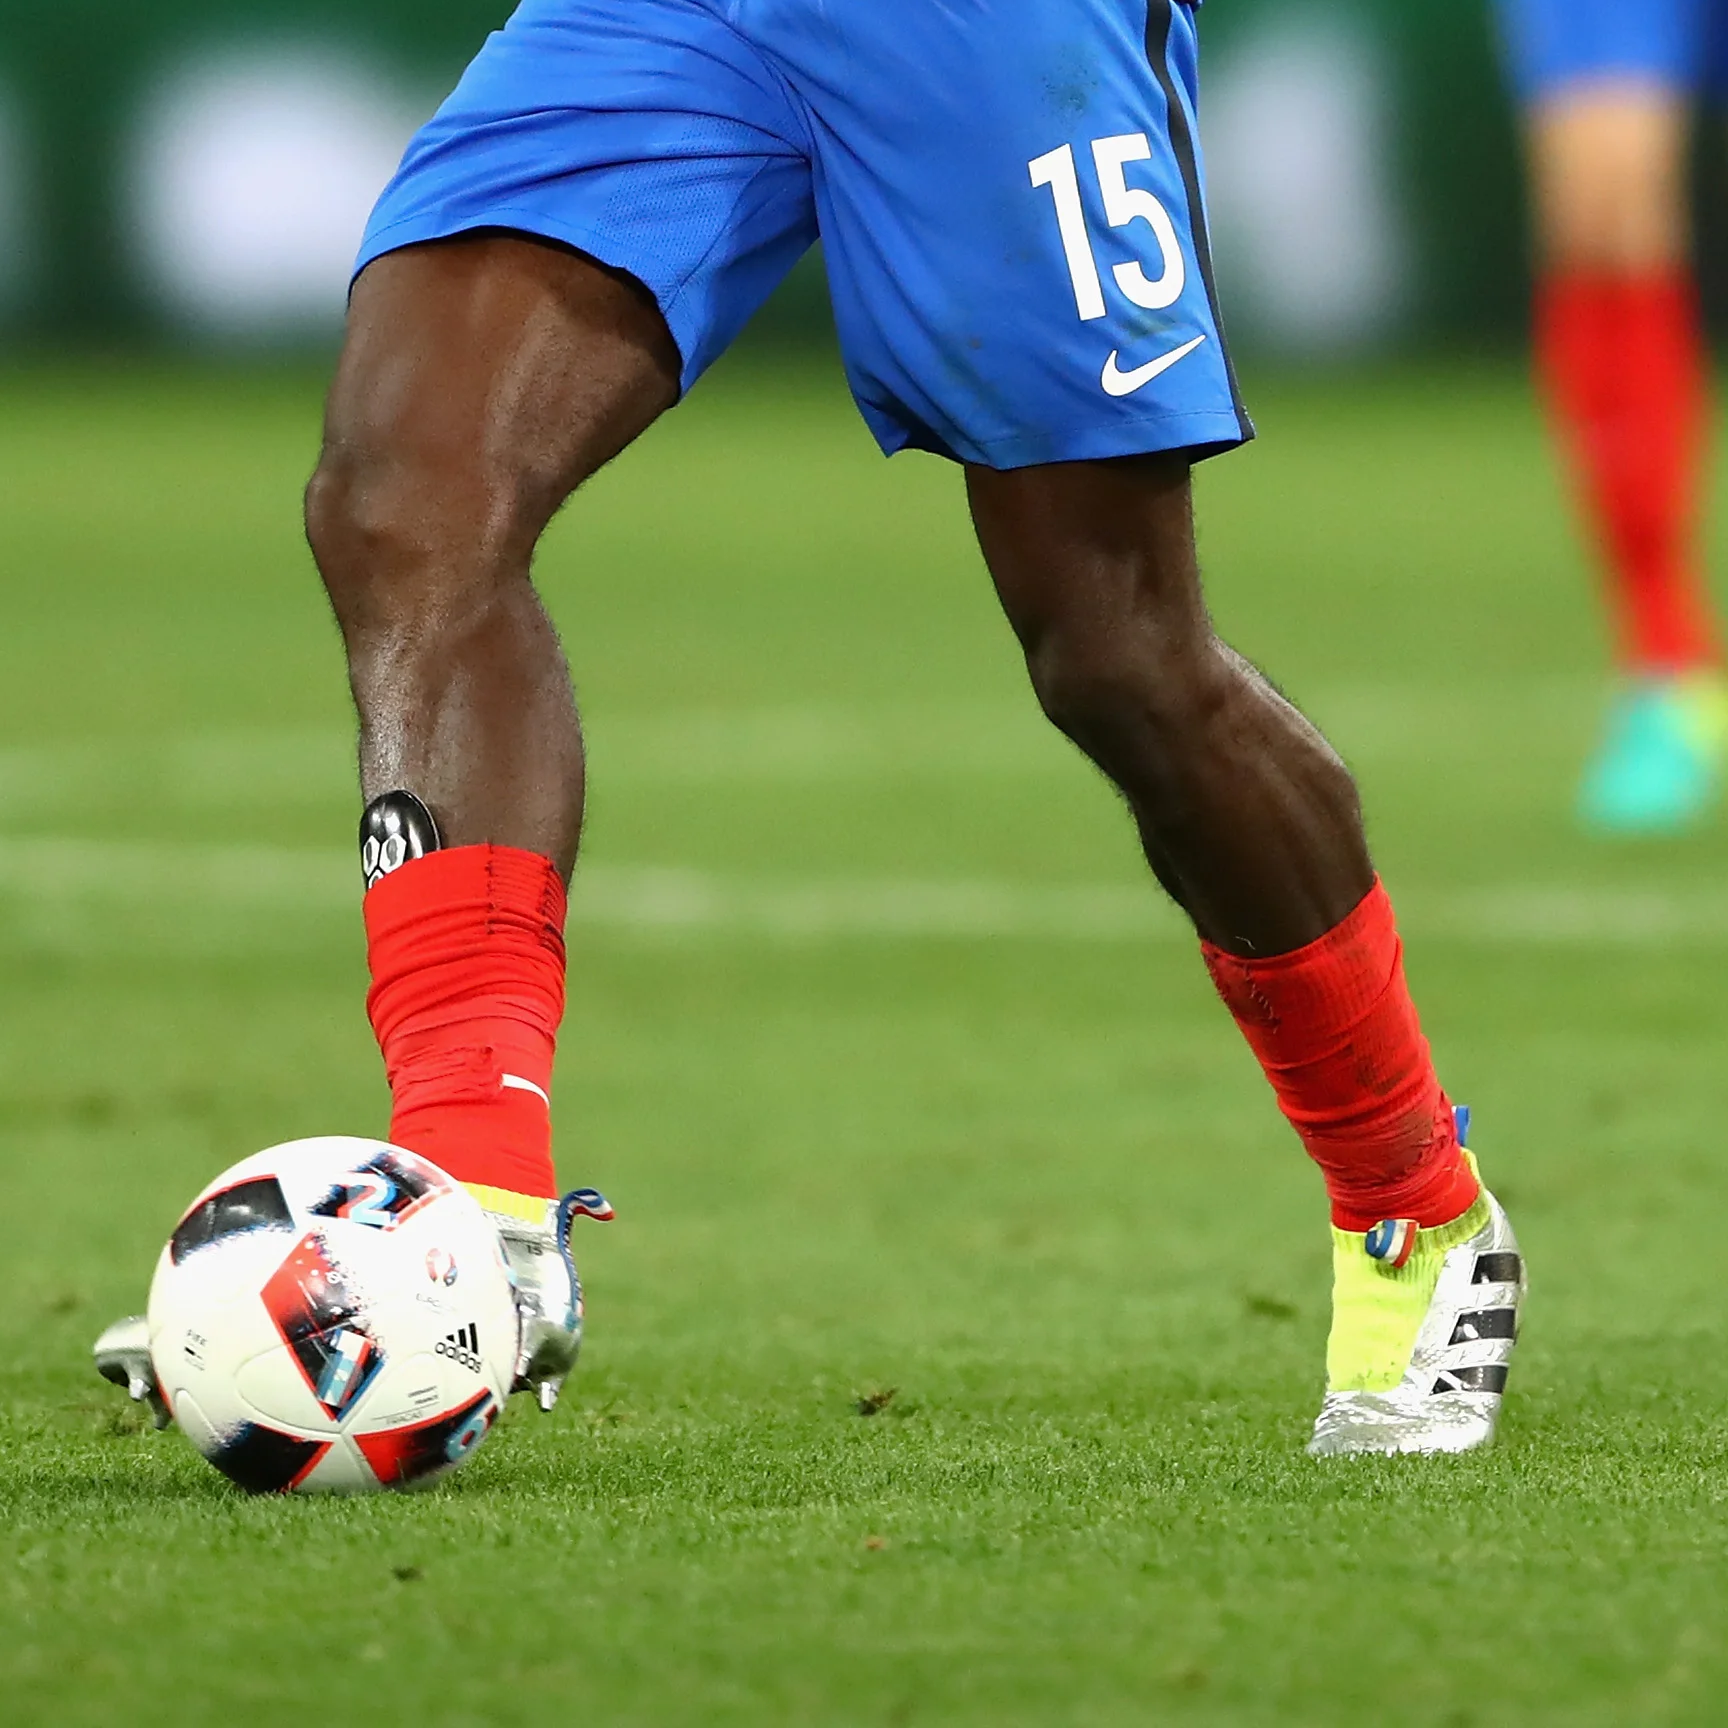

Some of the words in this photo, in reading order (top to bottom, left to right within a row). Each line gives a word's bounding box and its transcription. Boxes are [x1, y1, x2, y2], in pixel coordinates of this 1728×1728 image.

[1028, 132, 1186, 321] 15
[526, 1244, 543, 1256] 15
[435, 1341, 484, 1374] adidas
